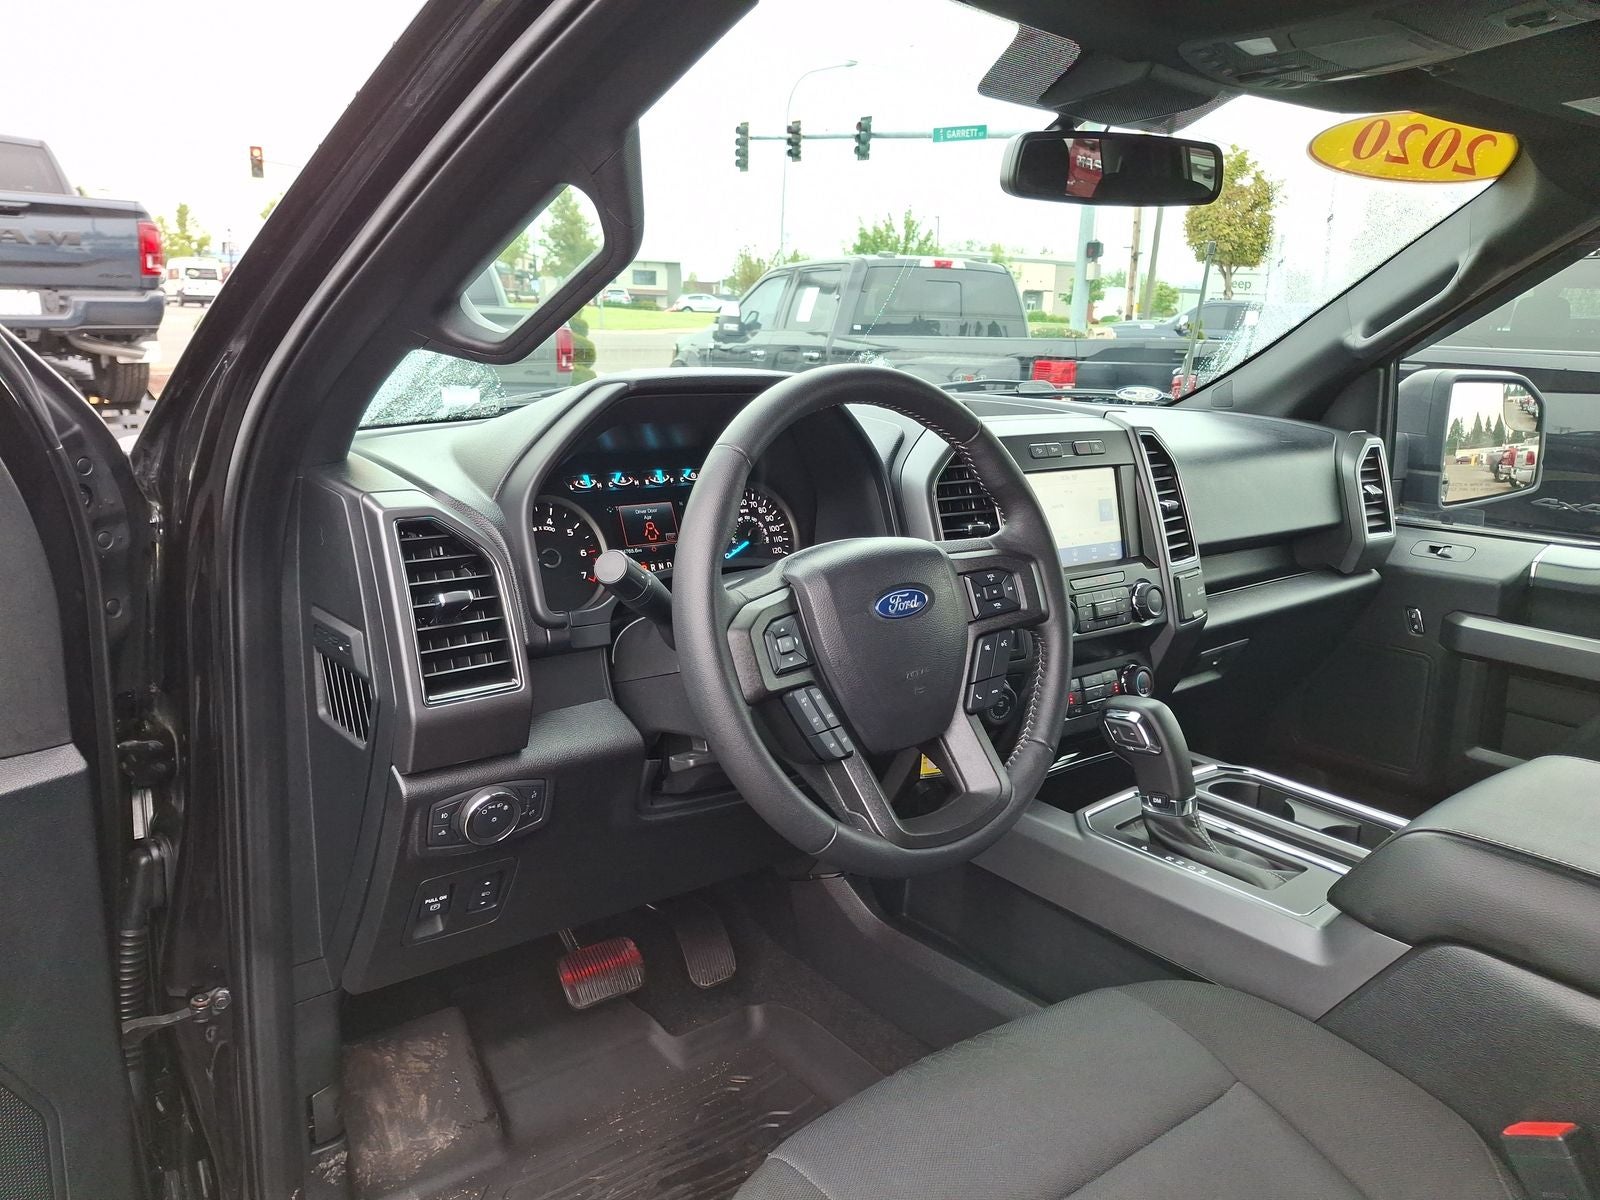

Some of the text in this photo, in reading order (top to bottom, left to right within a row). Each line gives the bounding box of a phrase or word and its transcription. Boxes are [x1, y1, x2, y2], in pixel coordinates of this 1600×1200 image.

[946, 128, 978, 139] GARRETT
[0, 228, 81, 246] AM
[1231, 280, 1252, 291] eep
[580, 549, 587, 557] 6
[650, 563, 656, 571] R
[658, 562, 664, 570] N
[581, 571, 587, 579] 7
[888, 593, 922, 614] Ford
